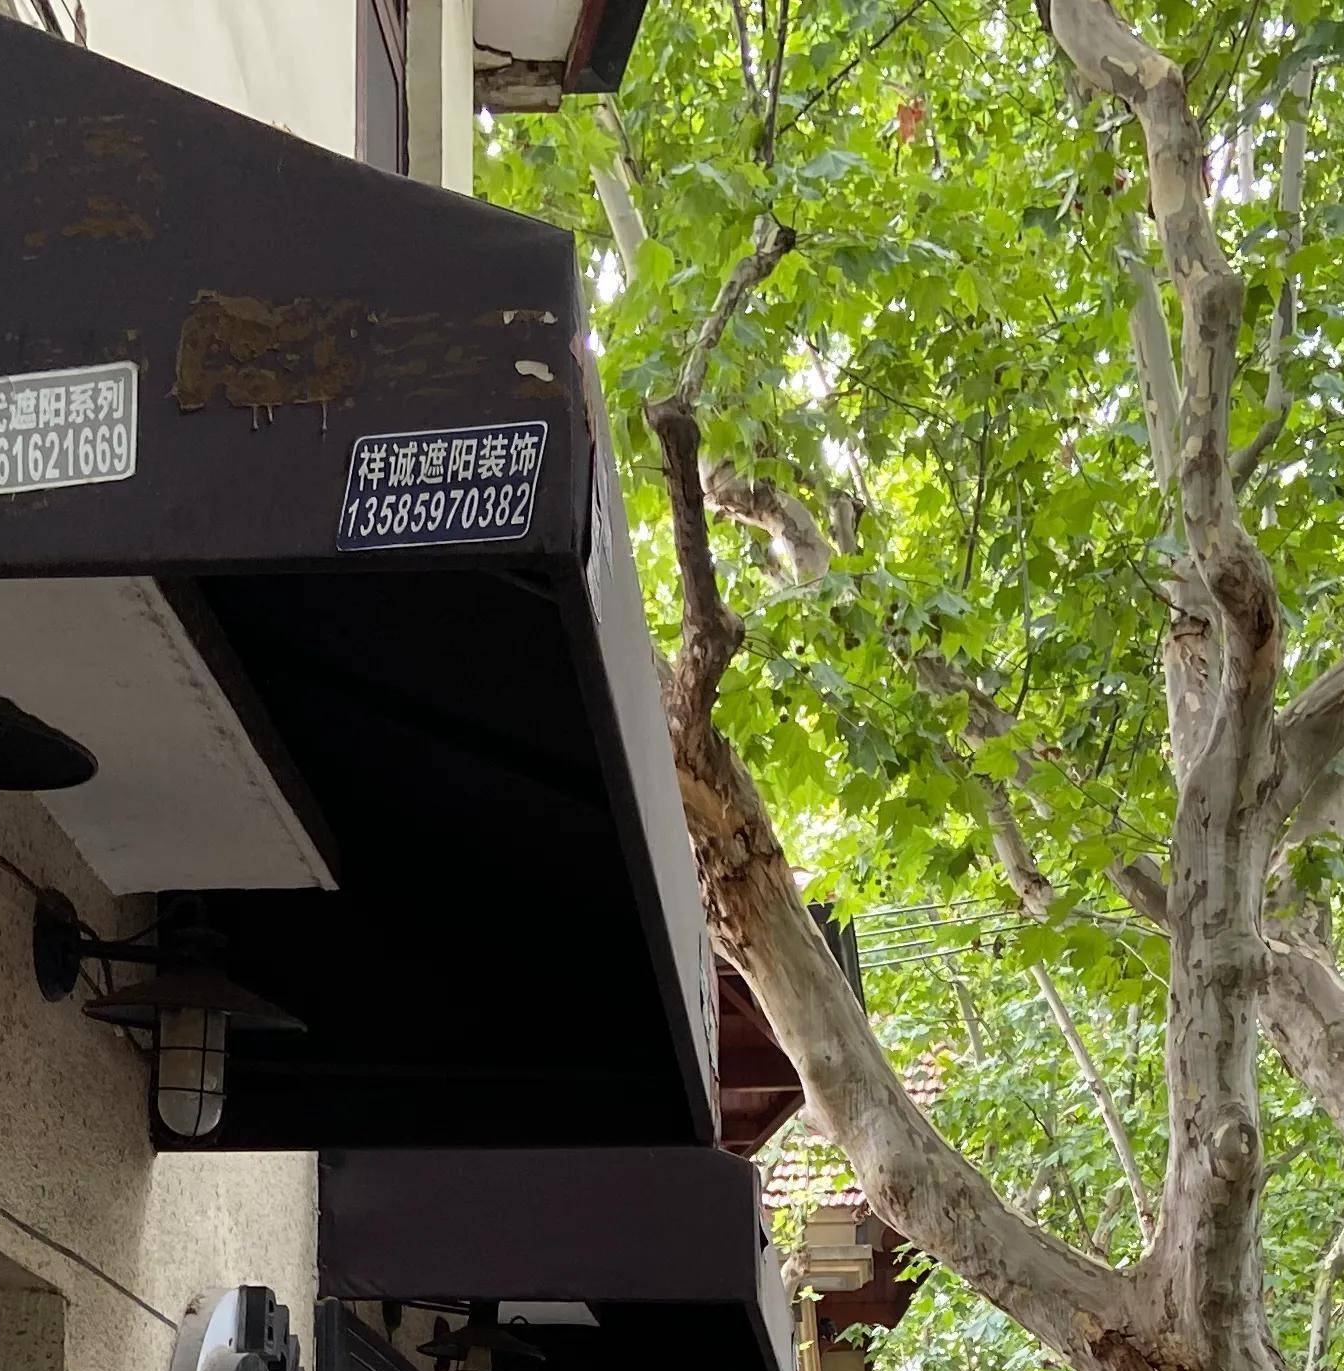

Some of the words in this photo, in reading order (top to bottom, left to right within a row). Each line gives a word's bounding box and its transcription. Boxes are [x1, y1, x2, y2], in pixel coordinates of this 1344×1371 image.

[357, 430, 538, 492] 祥诚遮阳装饰
[346, 482, 530, 539] 13585970382
